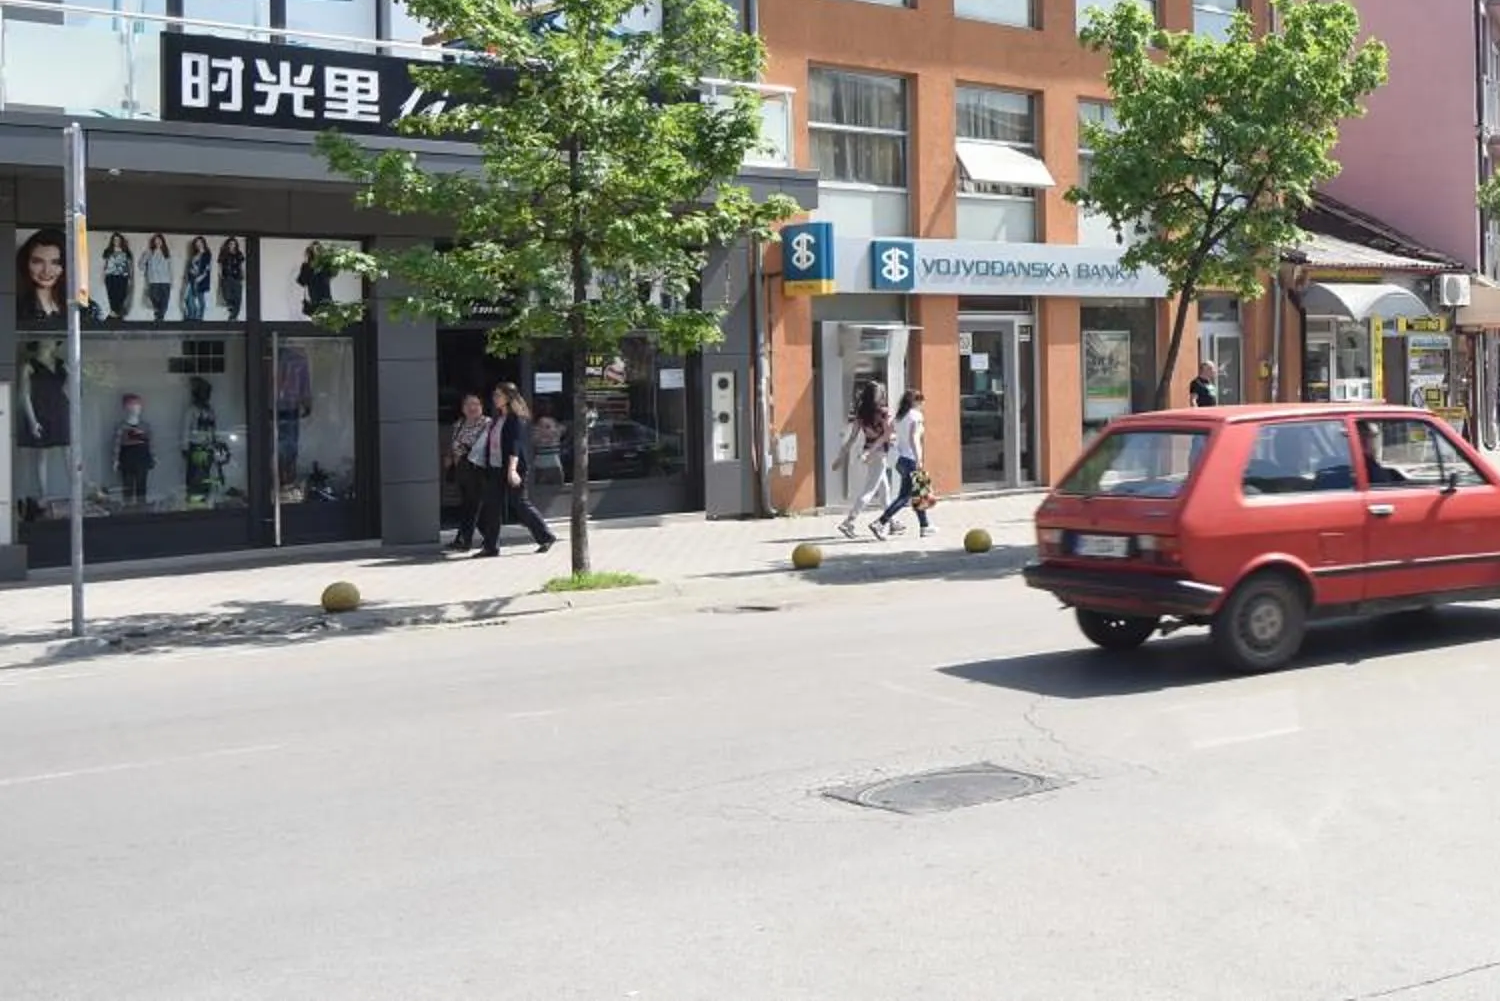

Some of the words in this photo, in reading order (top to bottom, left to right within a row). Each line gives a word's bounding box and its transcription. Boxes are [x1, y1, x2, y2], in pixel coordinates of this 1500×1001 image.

[181, 52, 380, 123] 时光里
[1076, 262, 1140, 280] BANKA
